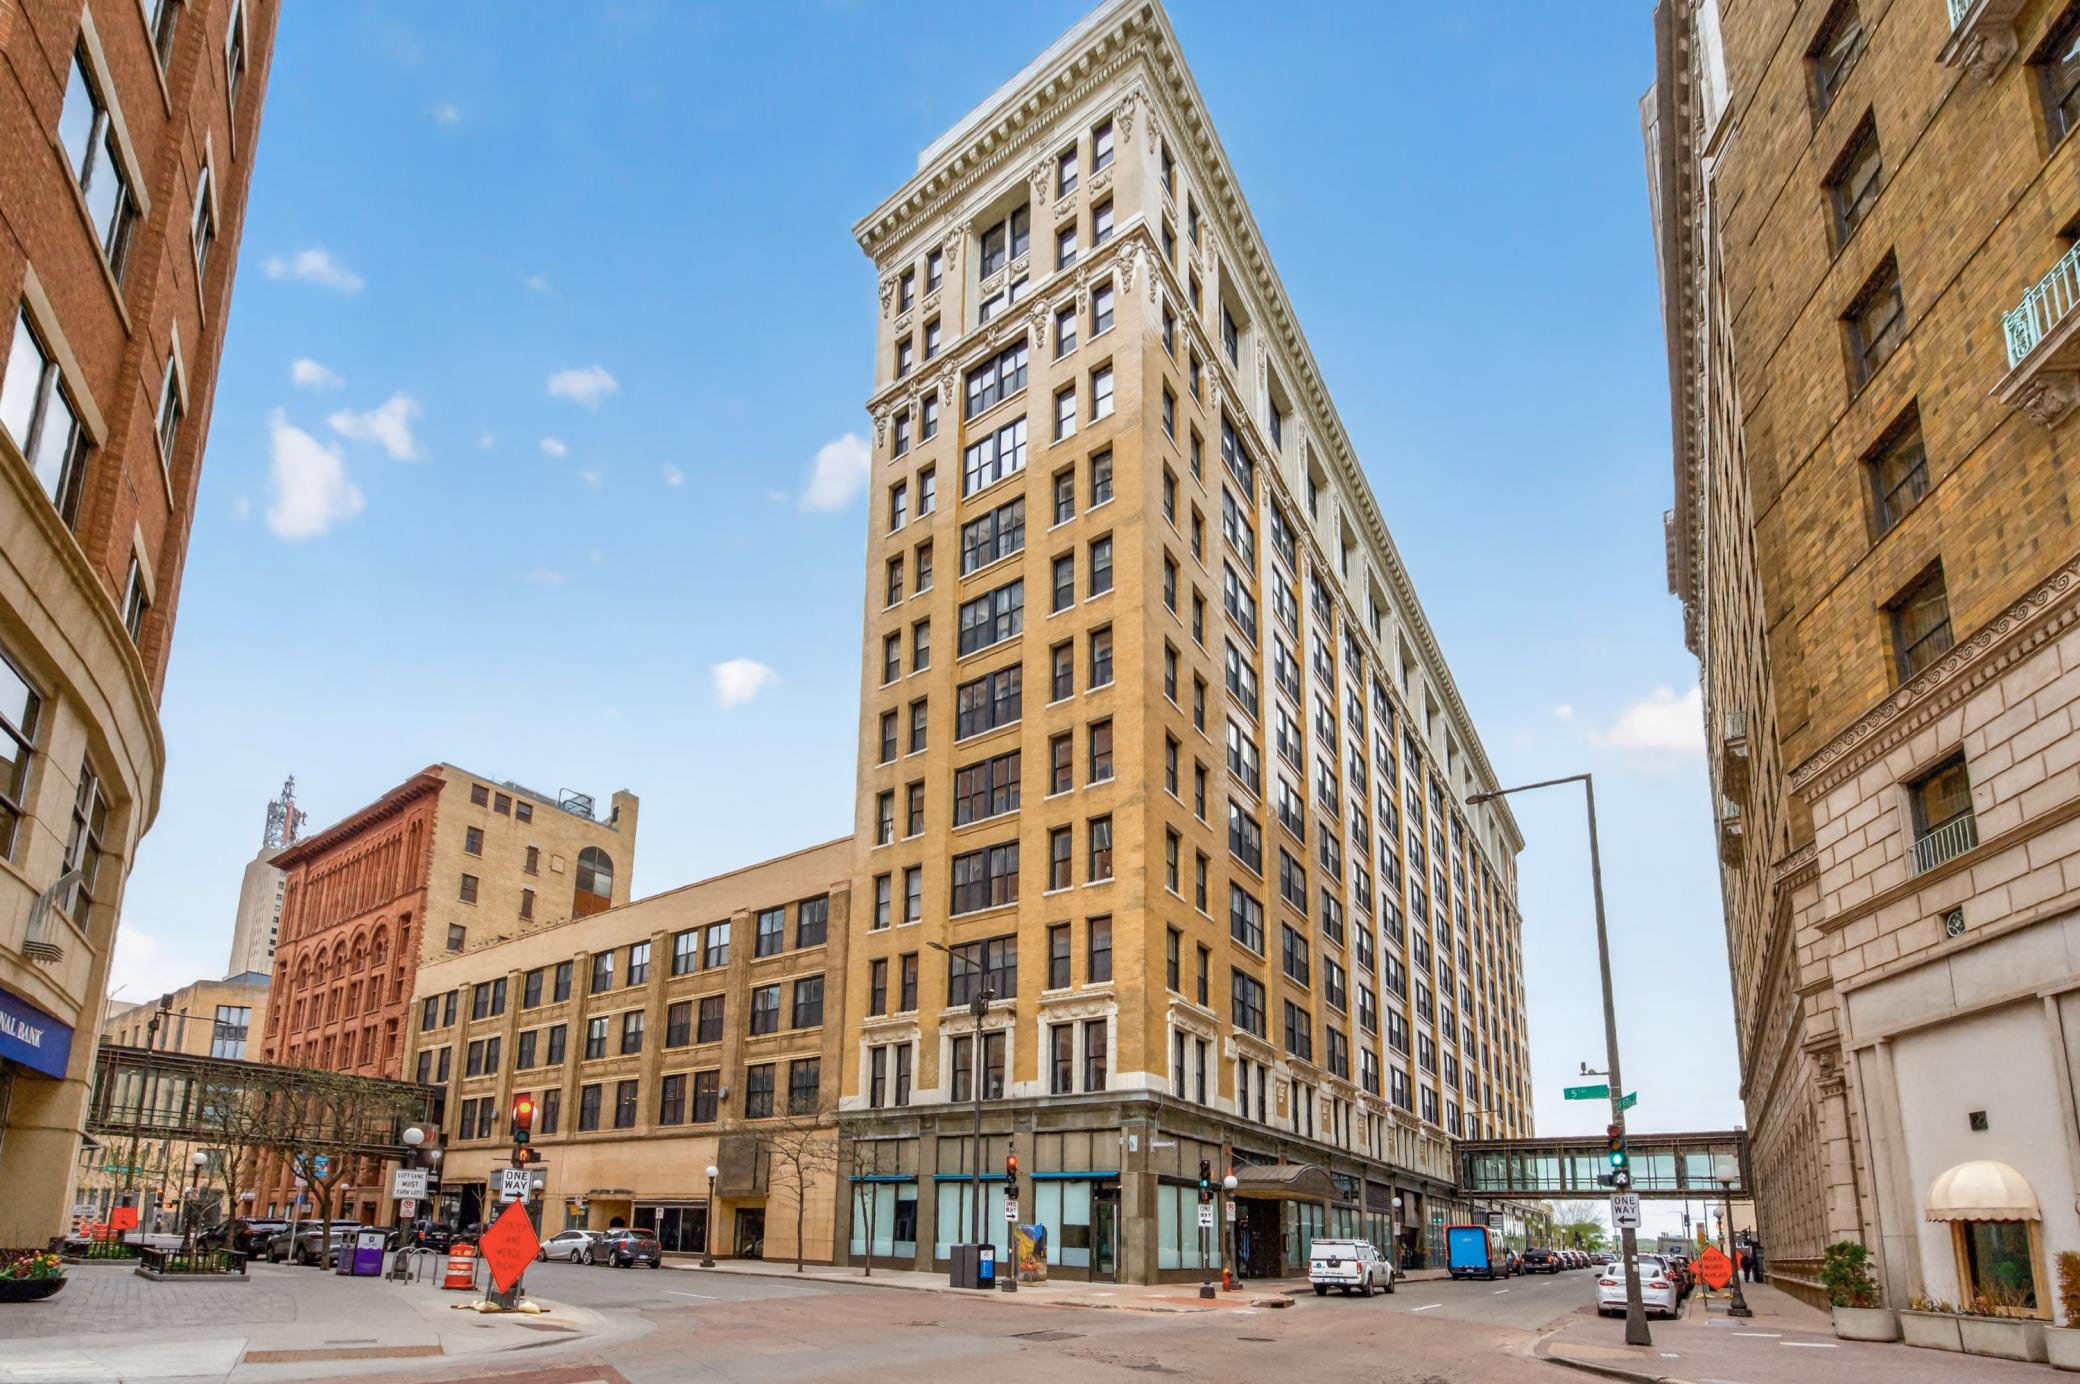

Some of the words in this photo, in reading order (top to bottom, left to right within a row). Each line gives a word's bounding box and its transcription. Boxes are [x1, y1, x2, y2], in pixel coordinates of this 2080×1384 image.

[18, 1021, 41, 1048] BANK
[506, 1171, 528, 1180] ONE
[505, 1180, 528, 1190] WAY
[1615, 1196, 1636, 1205] ONE
[1615, 1206, 1636, 1214] WAY
